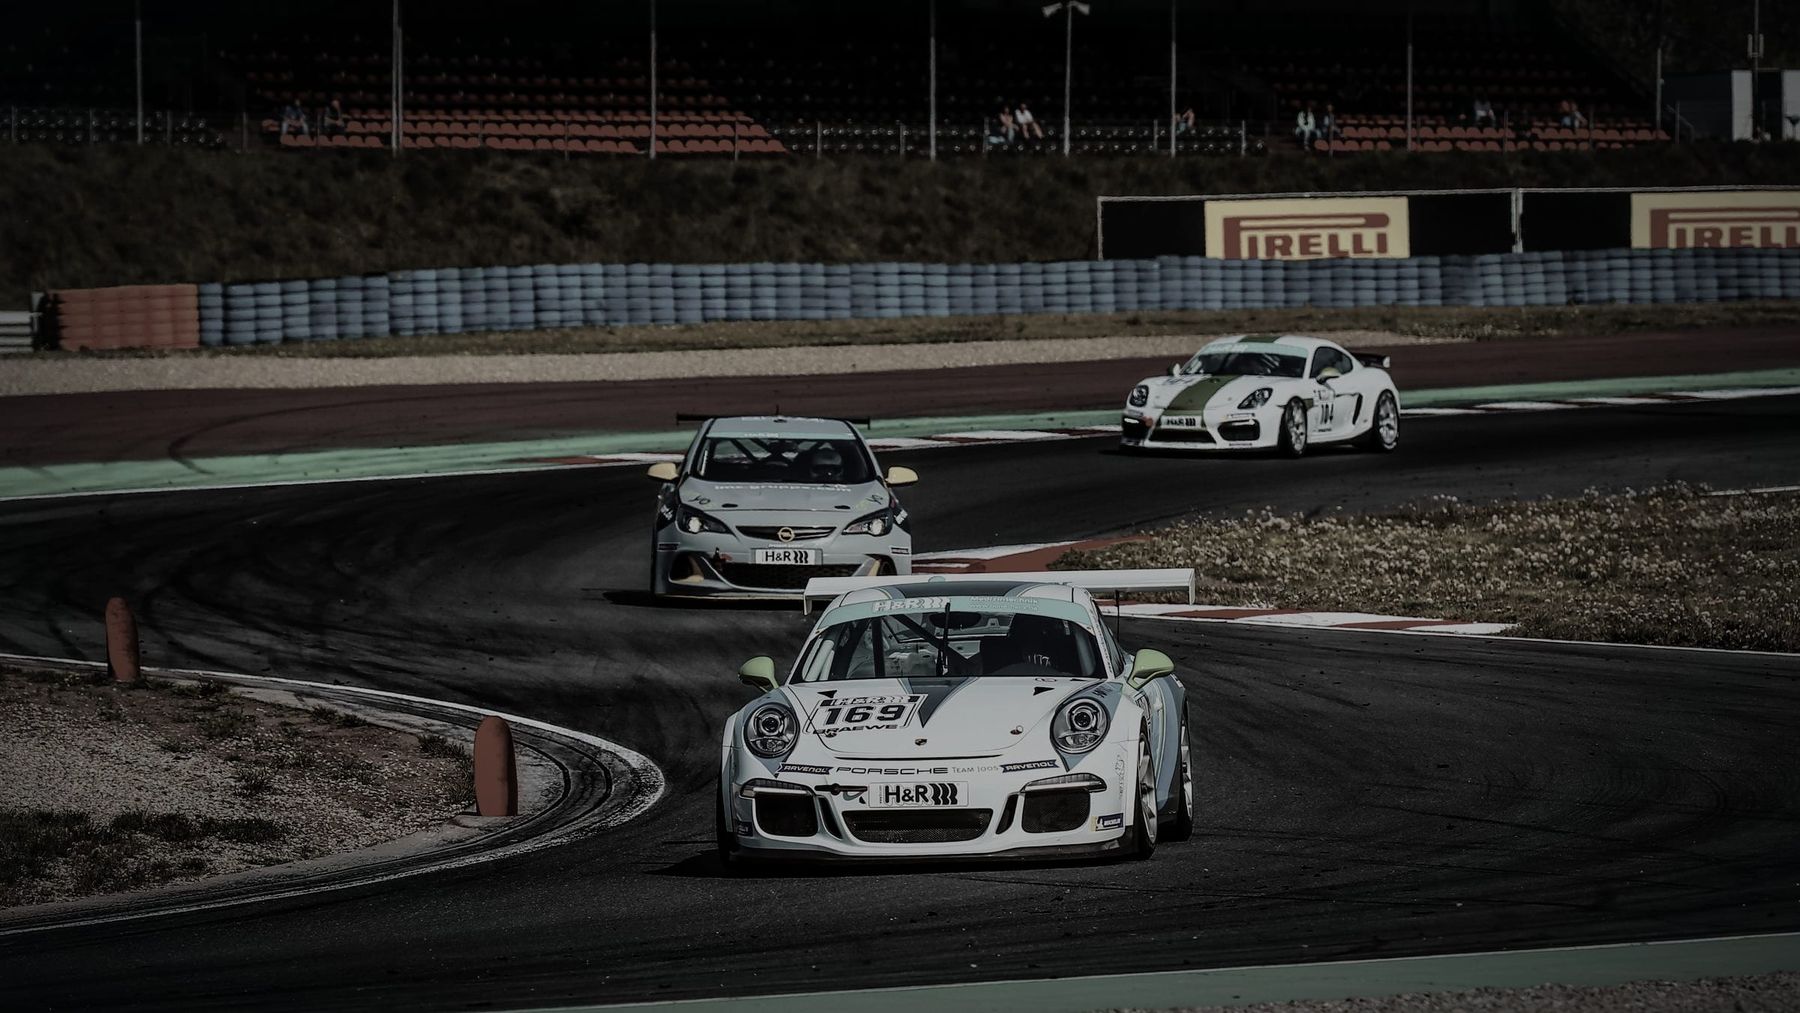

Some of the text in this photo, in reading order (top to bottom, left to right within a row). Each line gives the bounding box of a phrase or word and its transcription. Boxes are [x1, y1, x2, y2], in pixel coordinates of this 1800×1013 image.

[1651, 207, 1800, 249] PIRELL
[1223, 213, 1389, 260] PIRELLI
[765, 551, 792, 562] H&R
[825, 704, 906, 725] 169
[783, 764, 827, 774] RAVENOL
[836, 766, 949, 775] PORSCHE
[1006, 760, 1056, 771] RAVENOL
[884, 785, 929, 803] H&R
